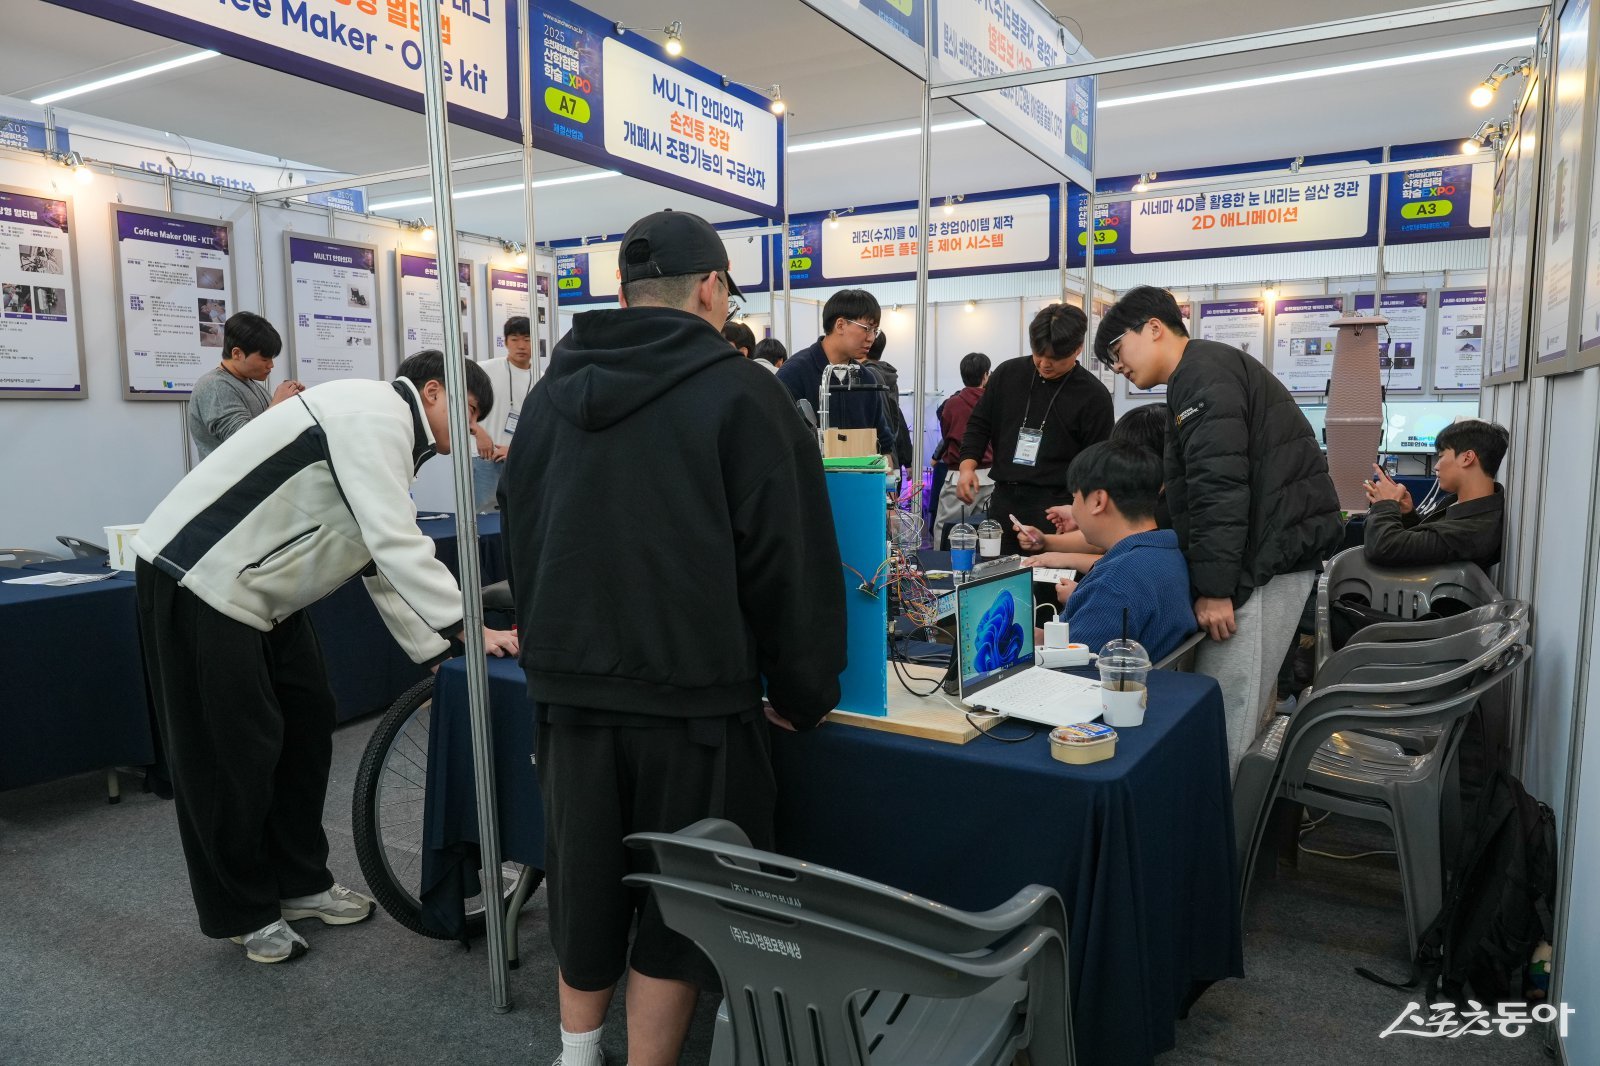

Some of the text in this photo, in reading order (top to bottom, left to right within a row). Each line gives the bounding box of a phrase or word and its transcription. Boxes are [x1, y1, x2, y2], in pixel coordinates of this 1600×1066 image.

[544, 24, 565, 43] 2025
[282, 0, 378, 55] Maker
[401, 39, 453, 82] Oe
[460, 58, 488, 94] kit
[544, 48, 580, 75] 산학협력
[543, 63, 592, 94] 학술EXPO
[559, 95, 577, 115] A7
[653, 73, 744, 131] MULTI 안마의자
[670, 110, 730, 152] 손전등 장갑
[623, 120, 766, 190] 개폐시 조명기능의 구급상자
[1402, 176, 1442, 190] 산학협력
[1402, 185, 1456, 199] 학술EXPO
[1139, 180, 1360, 216] 시네마 4D를 활용한 눈 내리는 설산 경관
[1416, 203, 1437, 215] A3
[852, 214, 1014, 244] 레진(수지)를 이한 창업아이템 제작
[1192, 206, 1298, 231] 2D 애니메이션
[134, 226, 159, 238] Coffee
[160, 231, 182, 241] Maker
[182, 233, 198, 243] ONE
[201, 236, 214, 245] KIT
[860, 243, 895, 260] 스마트
[938, 237, 962, 252] 제어
[966, 233, 1004, 250] 시스템
[313, 252, 333, 262] MULTI
[790, 260, 803, 269] A2
[565, 279, 574, 287] A1
